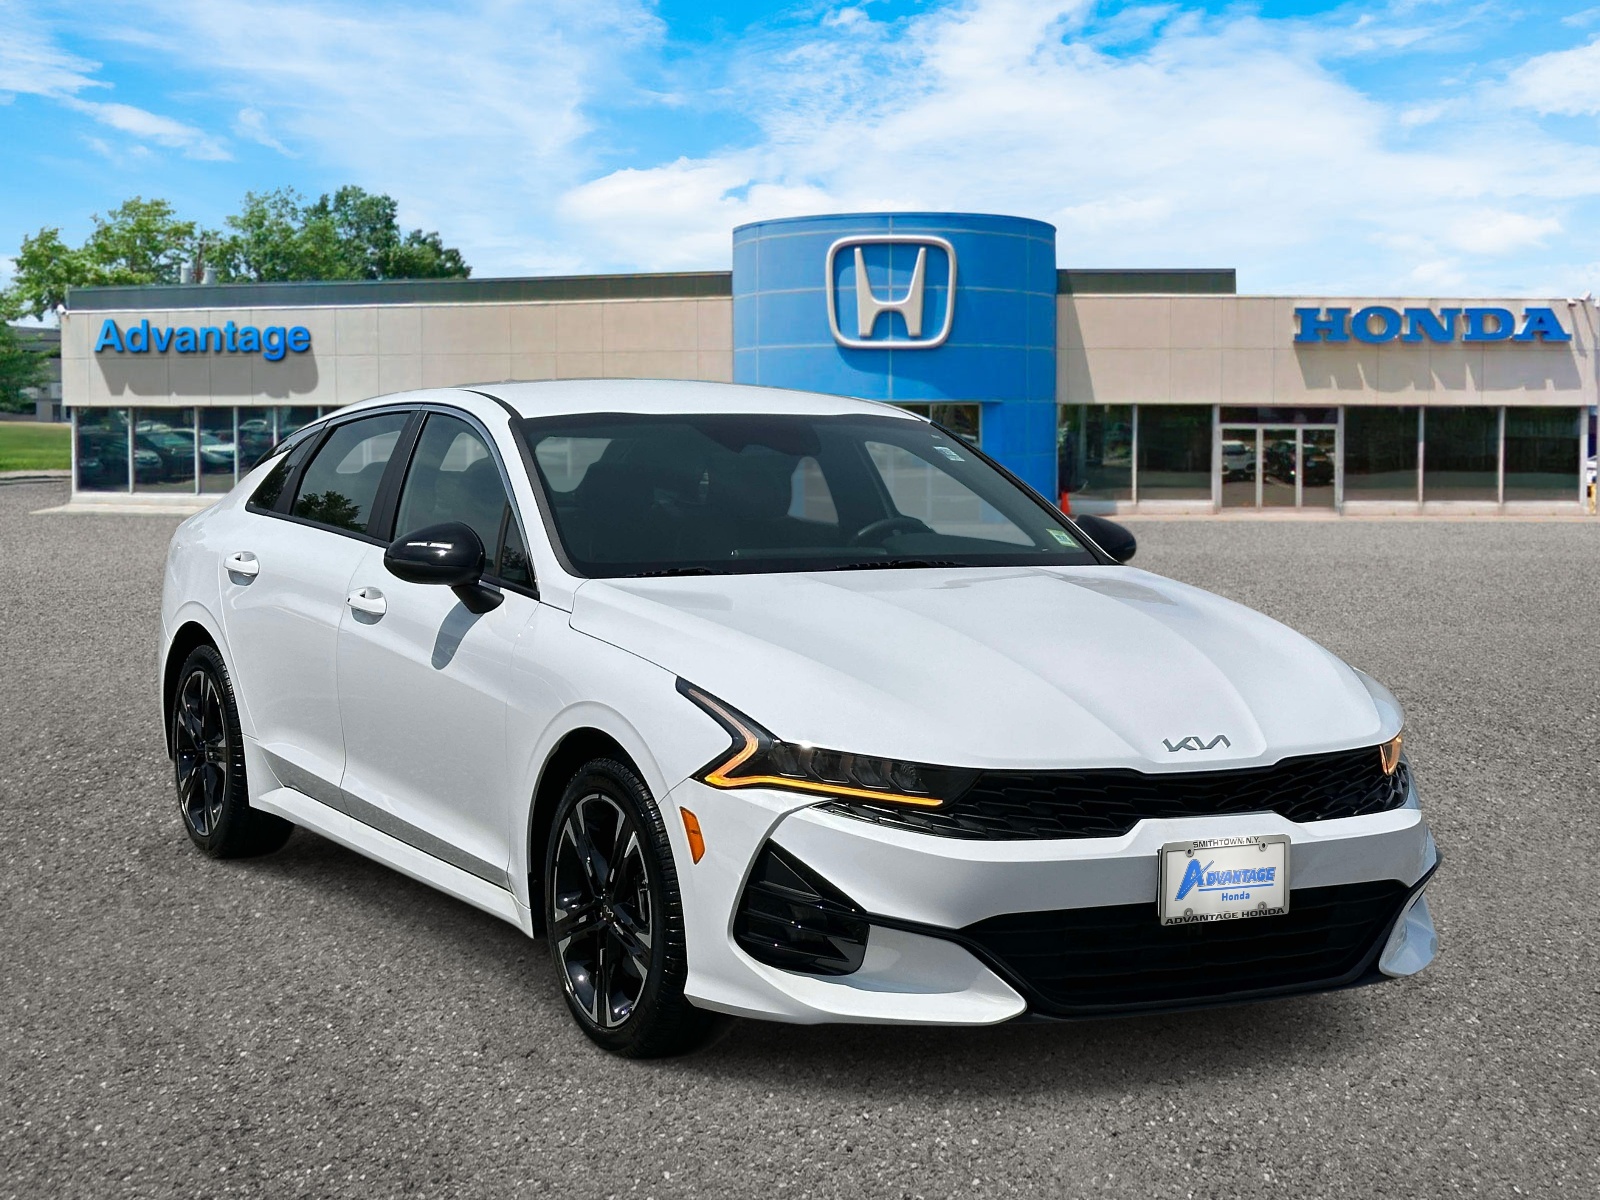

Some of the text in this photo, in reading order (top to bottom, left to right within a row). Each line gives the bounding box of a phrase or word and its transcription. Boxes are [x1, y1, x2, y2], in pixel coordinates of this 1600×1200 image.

[94, 319, 311, 361] Advantage
[1294, 306, 1572, 343] HONDA
[1174, 859, 1276, 901] ADVANTAGE
[1221, 891, 1250, 901] Honda
[1165, 907, 1285, 925] ADVANTAGE HONDA
